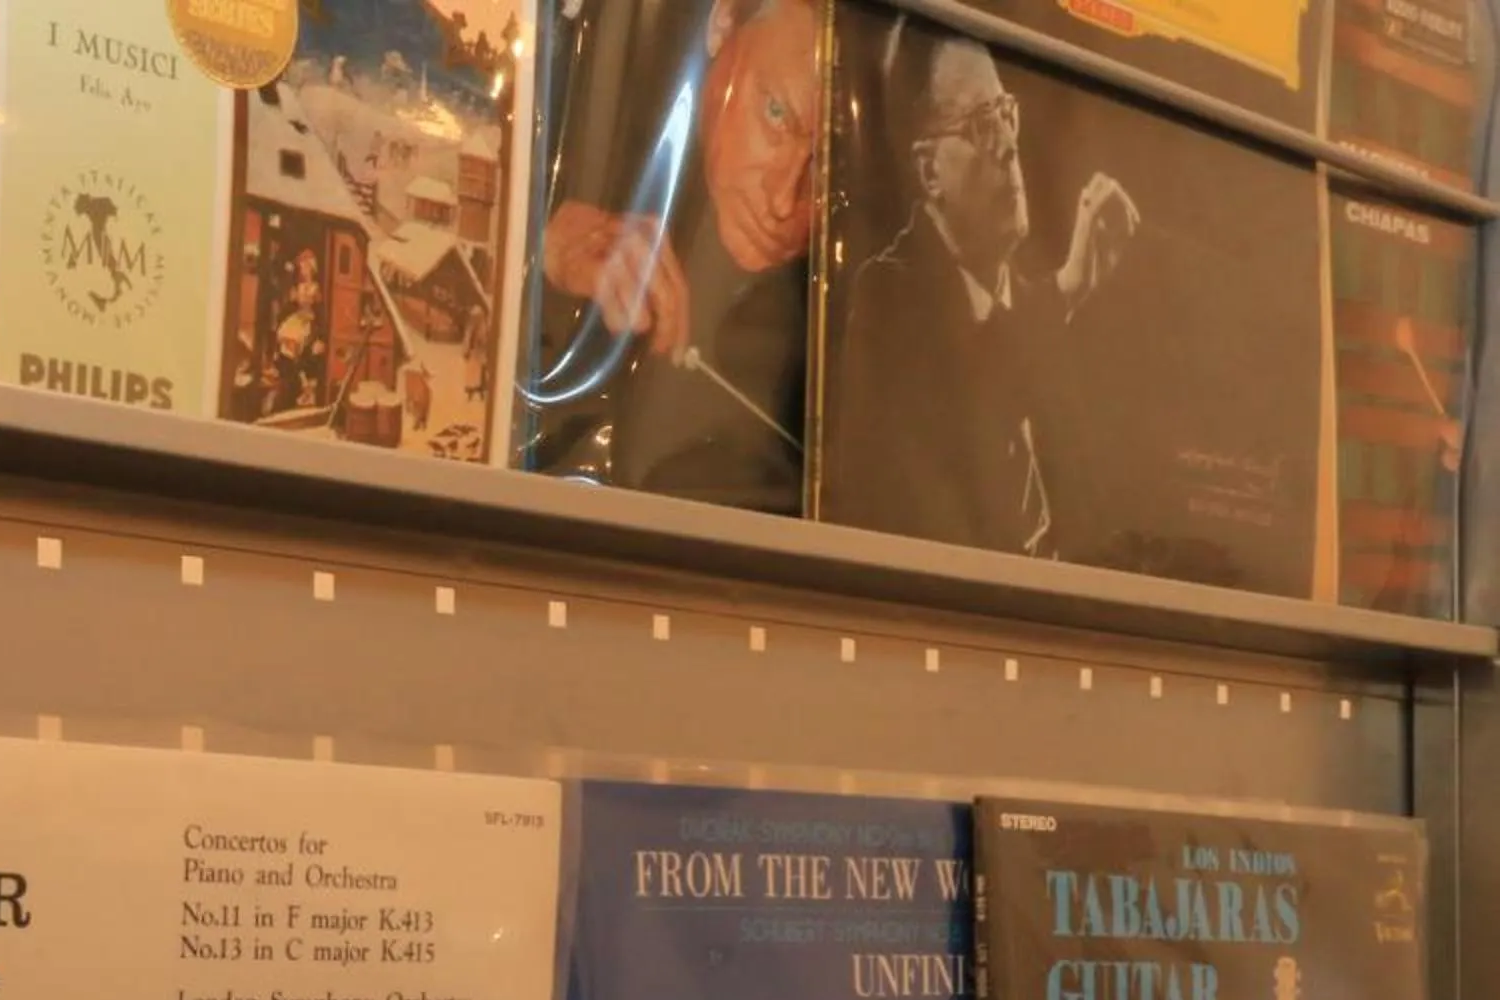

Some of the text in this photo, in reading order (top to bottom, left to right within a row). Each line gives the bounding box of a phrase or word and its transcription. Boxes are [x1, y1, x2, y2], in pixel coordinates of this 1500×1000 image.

[47, 21, 59, 47] I
[74, 29, 179, 80] MUSICI
[1346, 201, 1430, 244] CHIAPAS
[20, 353, 174, 410] PHILIPS
[183, 825, 328, 856] Concertos for
[1000, 812, 1058, 832] STEREO
[183, 857, 398, 891] Piano and Orchestra
[636, 850, 744, 898] FROM
[757, 853, 832, 900] THE
[845, 857, 923, 900] NEW
[934, 858, 969, 901] W
[1182, 845, 1297, 877] LOS INDIOS
[180, 901, 434, 935] No.11 in F major K.413
[1046, 870, 1300, 945] TABAJARAS
[180, 935, 436, 967] No.13 in C major K.415
[852, 954, 965, 997] UNFINI
